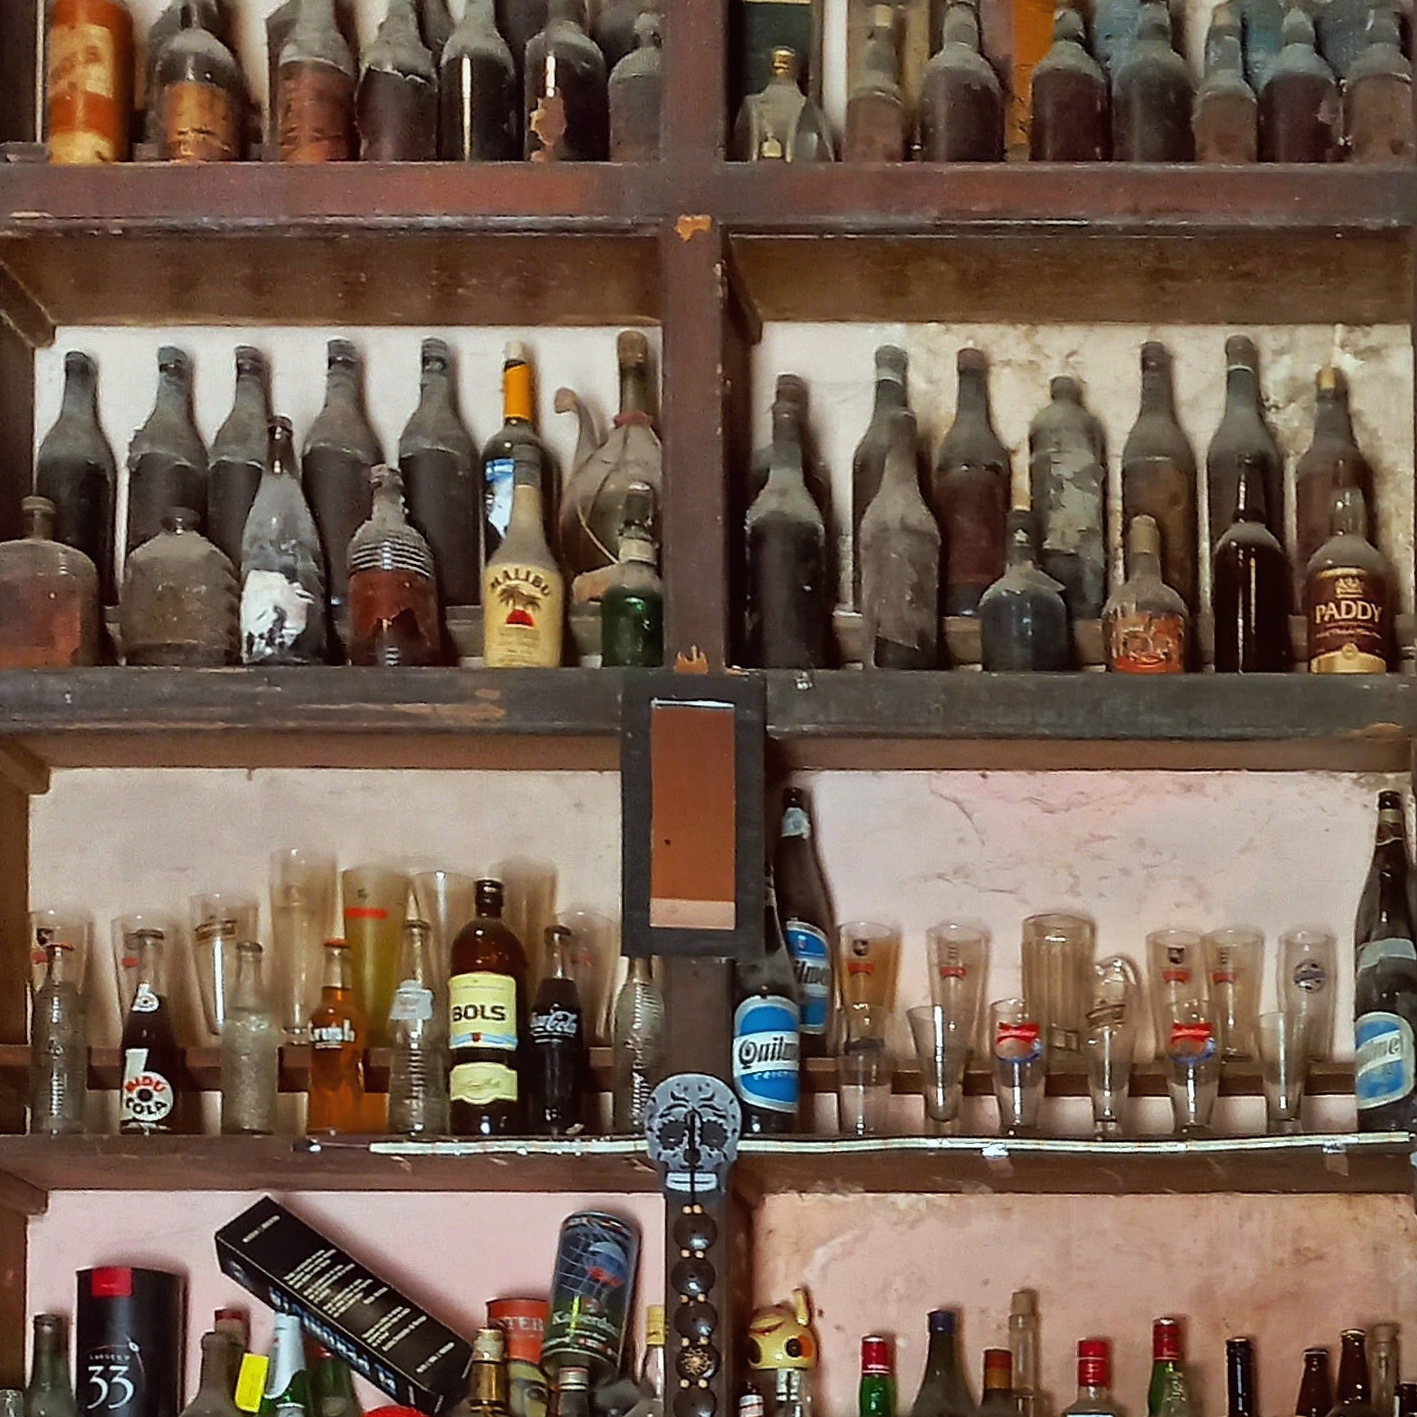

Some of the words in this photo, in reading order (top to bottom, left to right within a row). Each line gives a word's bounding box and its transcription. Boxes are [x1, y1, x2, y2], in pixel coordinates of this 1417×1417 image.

[1315, 600, 1383, 624] PADDY
[452, 1004, 506, 1022] BOLS
[126, 1097, 168, 1116] COLA
[87, 1365, 135, 1409] 33
